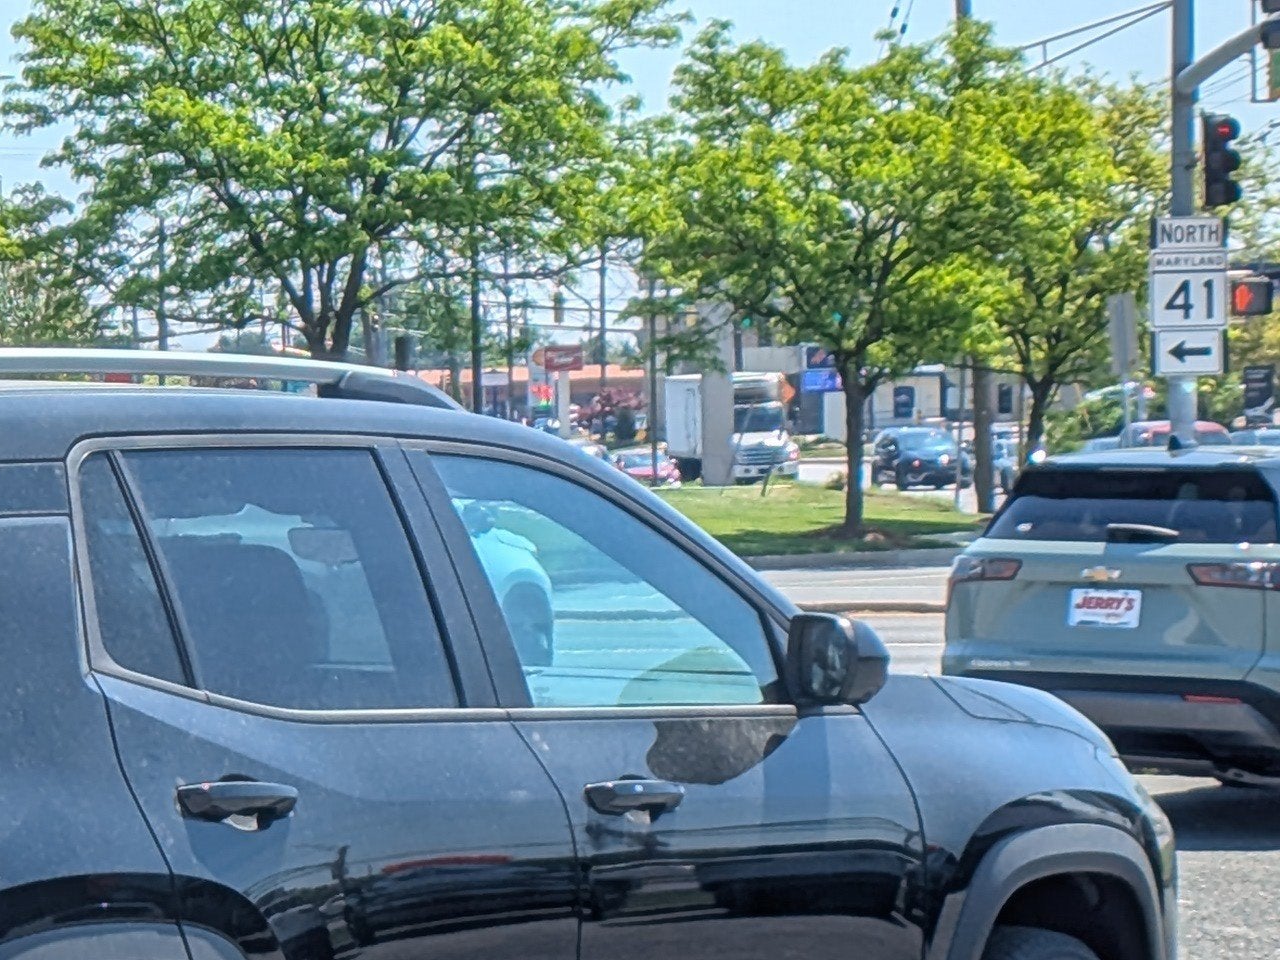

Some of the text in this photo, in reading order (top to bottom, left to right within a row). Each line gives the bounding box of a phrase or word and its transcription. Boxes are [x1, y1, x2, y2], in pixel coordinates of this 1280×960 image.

[1160, 223, 1220, 243] NORTH
[1156, 256, 1224, 267] MARYLAND
[1164, 278, 1215, 320] 41
